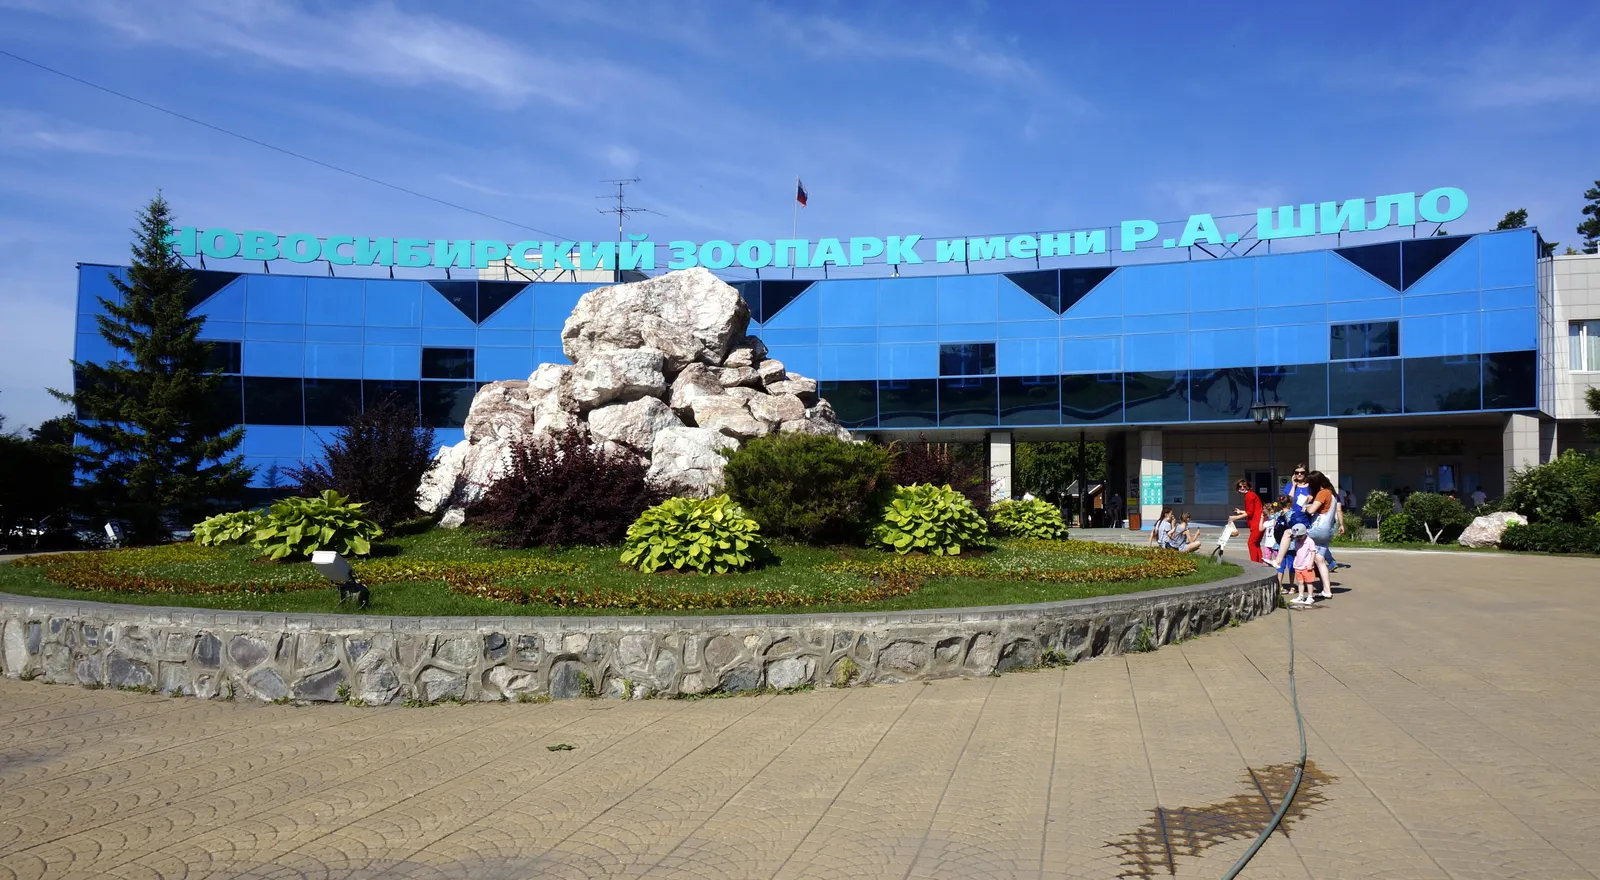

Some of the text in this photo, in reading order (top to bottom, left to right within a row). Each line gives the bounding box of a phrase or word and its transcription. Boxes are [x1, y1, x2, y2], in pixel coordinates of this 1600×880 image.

[162, 187, 1469, 271] НОВОСИБИРСКИЙ ЗООПАРК имени Р.А. ШИЛО
